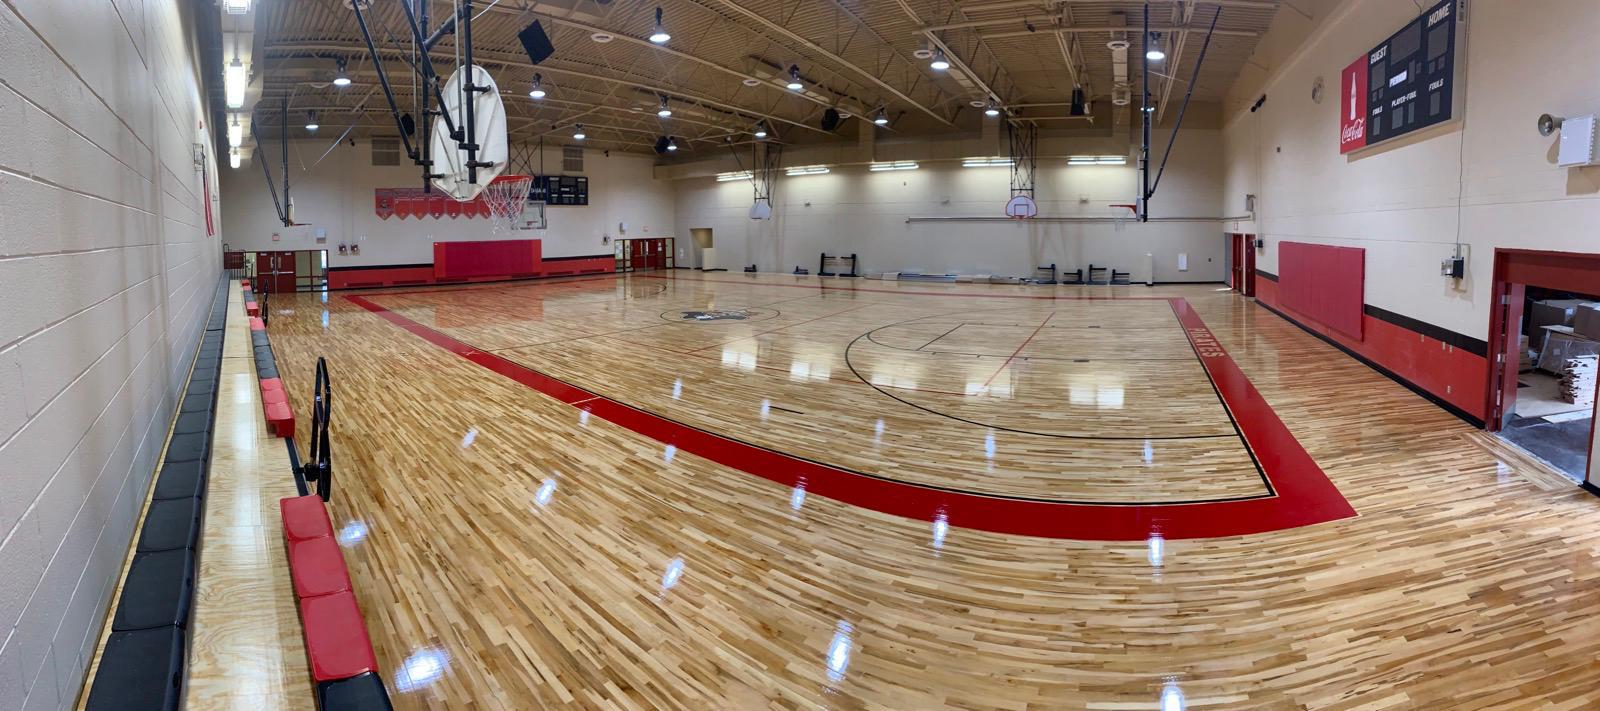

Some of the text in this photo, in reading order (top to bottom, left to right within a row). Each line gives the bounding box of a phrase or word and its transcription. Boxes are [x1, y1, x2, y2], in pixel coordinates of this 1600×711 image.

[1428, 2, 1451, 27] HOME
[1370, 45, 1388, 64] GUEST
[1428, 78, 1444, 91] FOULS
[1188, 328, 1226, 358] PIRATES
